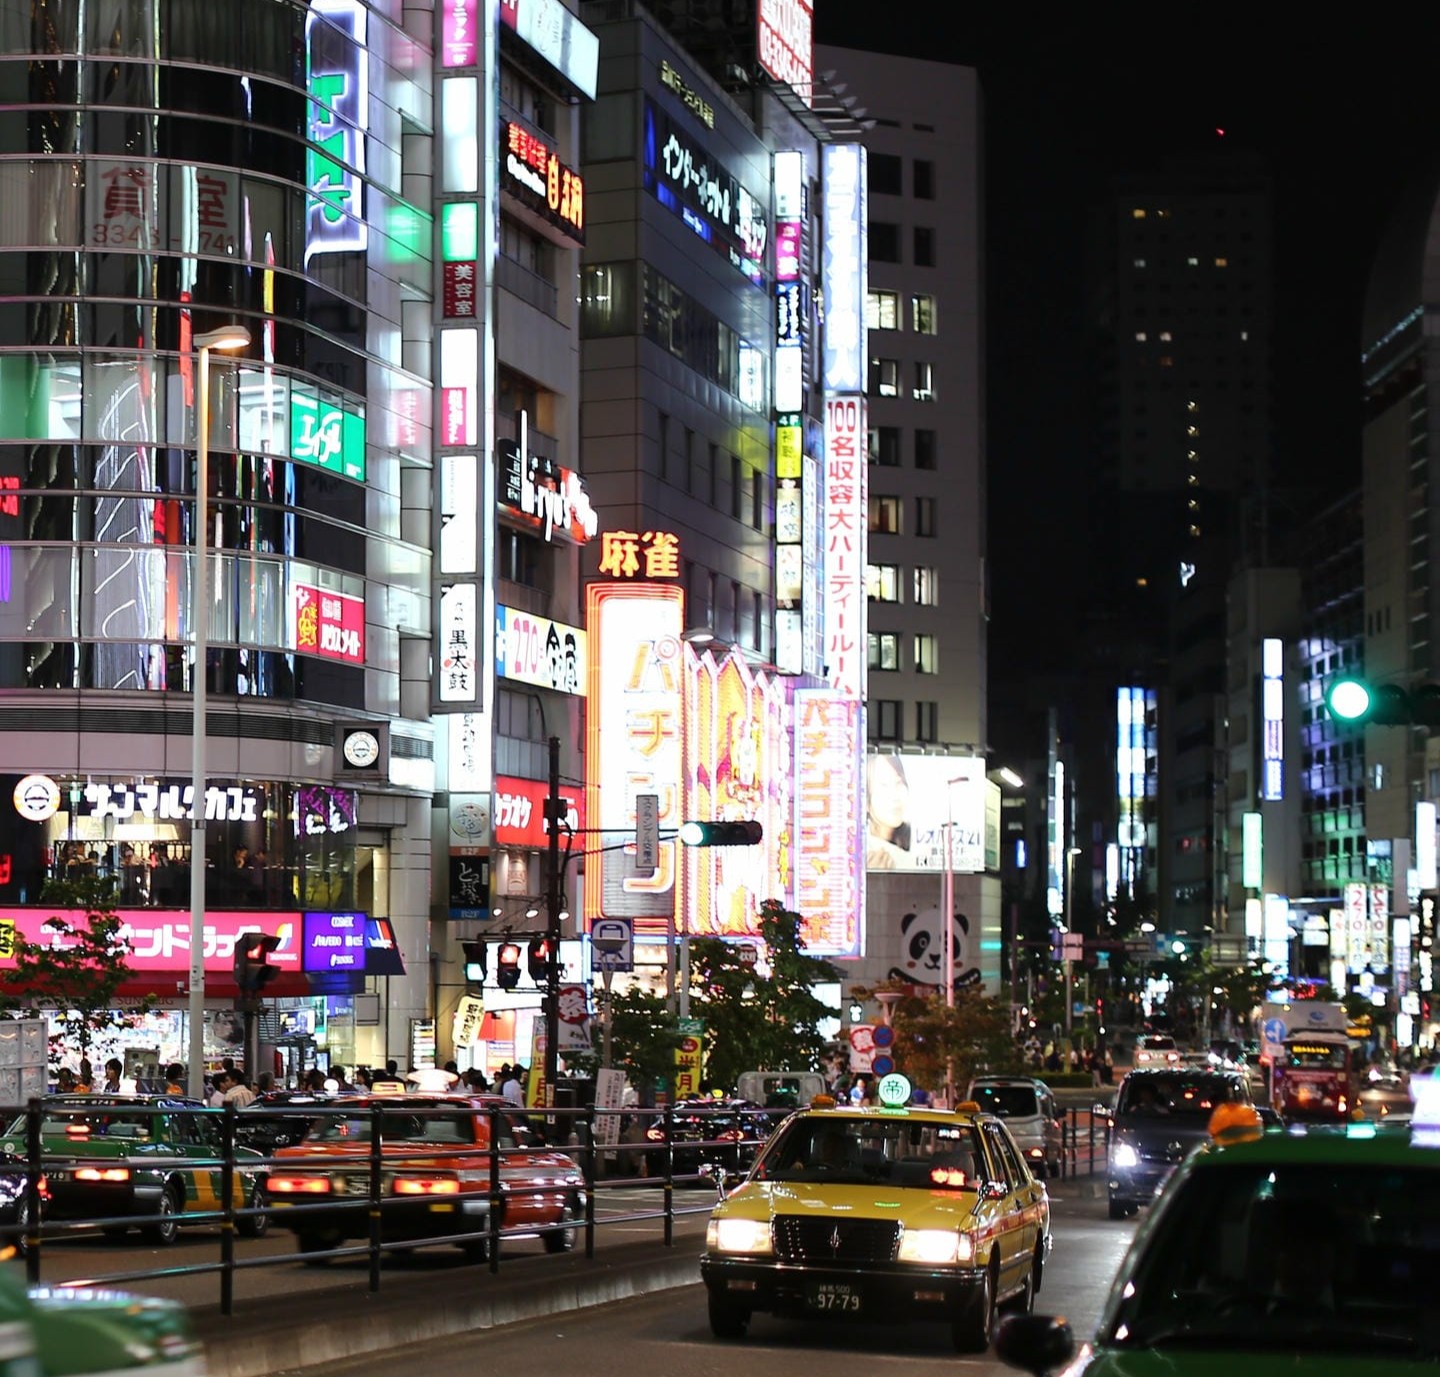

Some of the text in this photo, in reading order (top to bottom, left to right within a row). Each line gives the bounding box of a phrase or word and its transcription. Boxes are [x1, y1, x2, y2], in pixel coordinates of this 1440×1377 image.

[455, 264, 473, 316] 美容室
[599, 530, 680, 578] 麻雀
[83, 784, 257, 822] サンマルクカフェ
[117, 996, 174, 1005] SUNUG
[818, 1294, 859, 1310] 97-79
